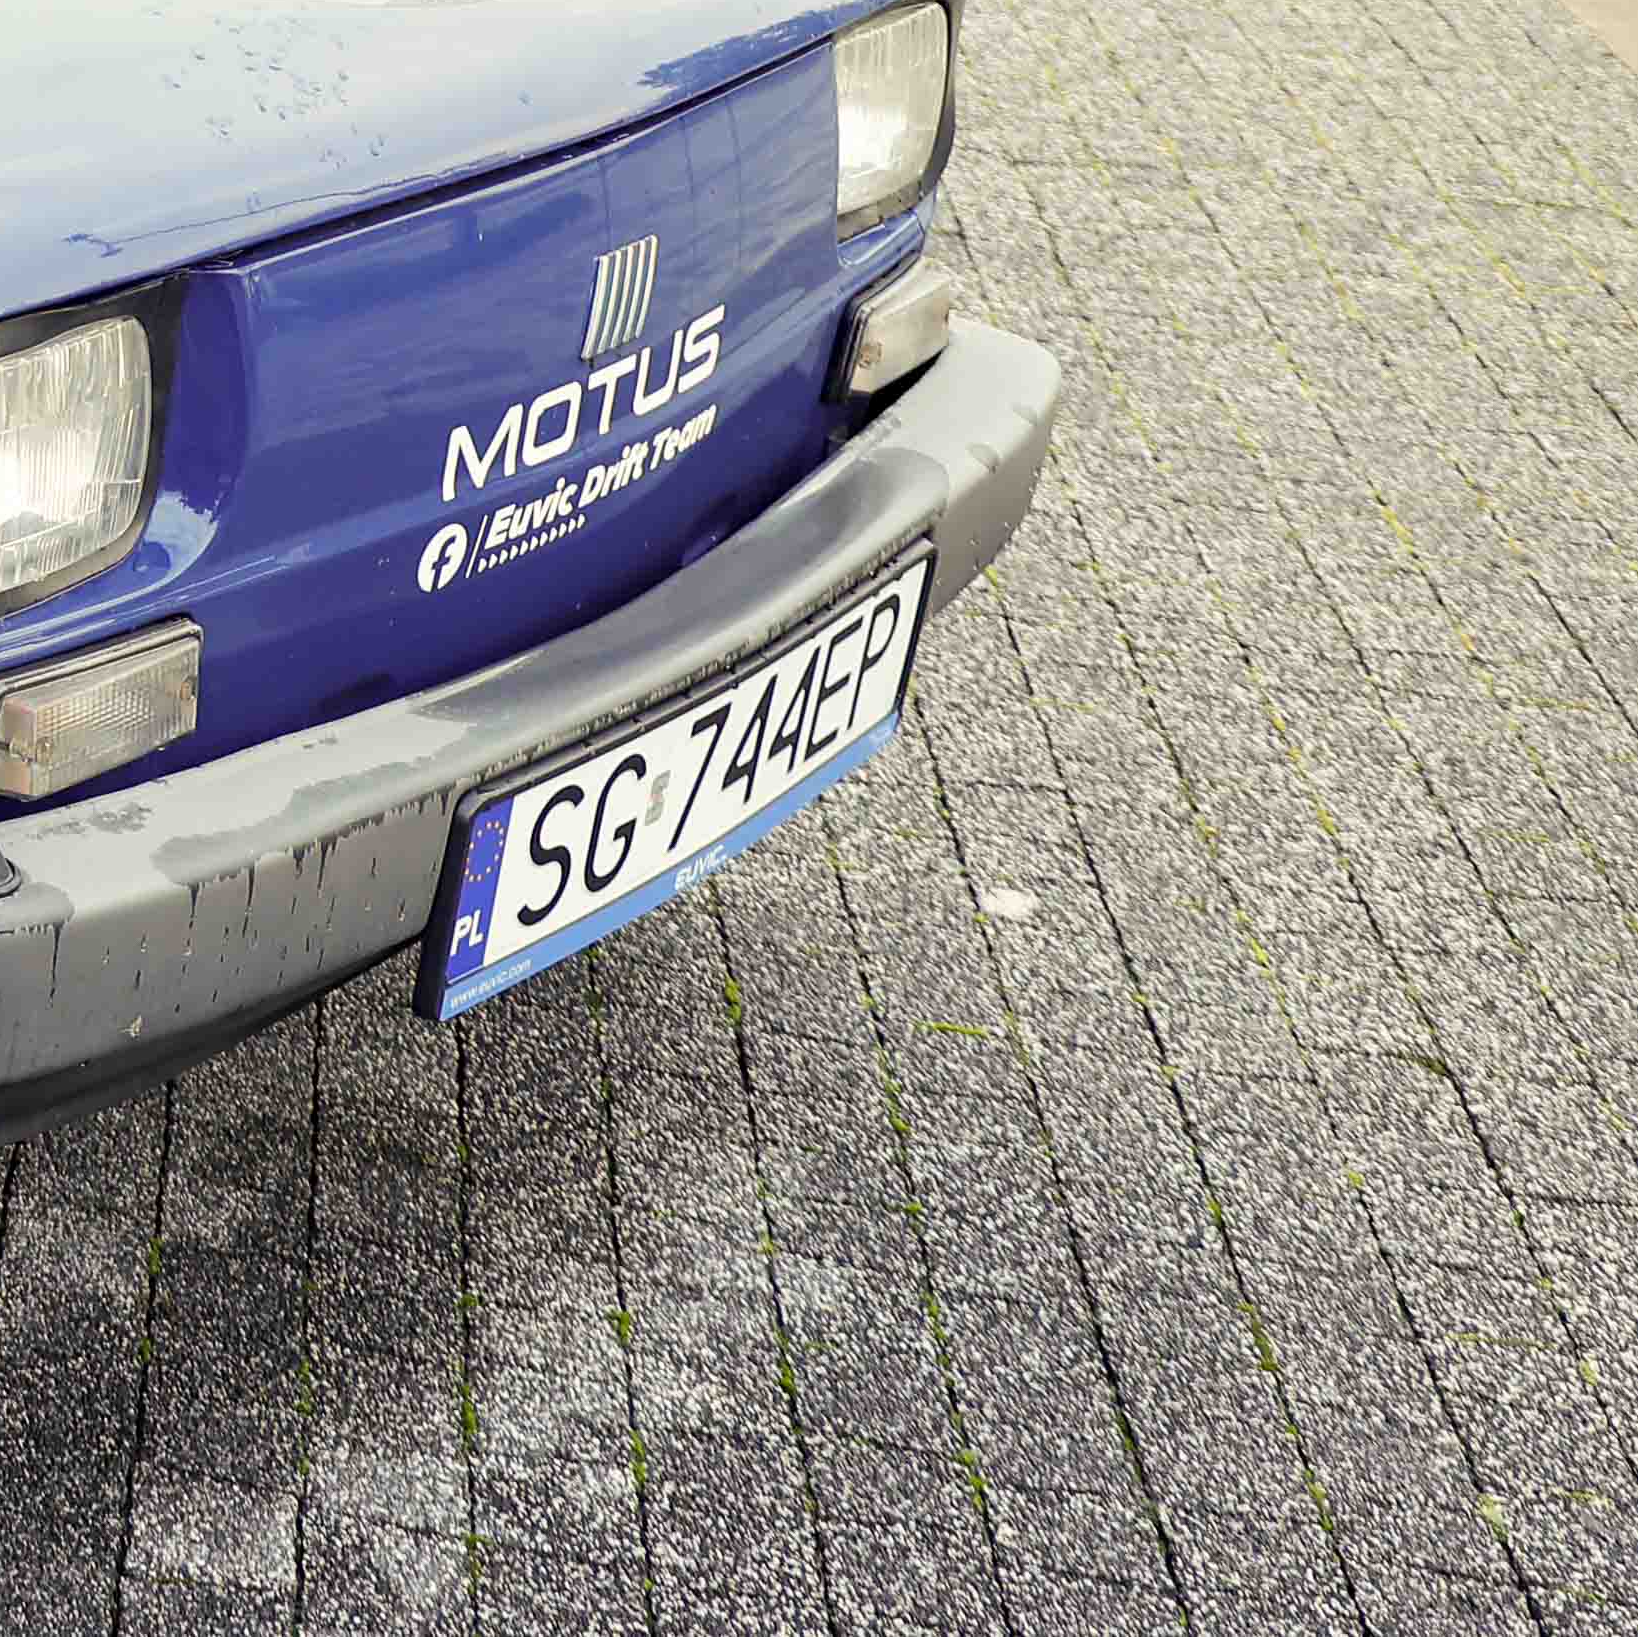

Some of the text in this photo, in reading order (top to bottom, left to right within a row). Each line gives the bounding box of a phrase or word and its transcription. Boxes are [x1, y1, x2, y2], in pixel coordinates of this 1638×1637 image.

[442, 305, 725, 502] MOTUS
[484, 404, 715, 550] Euvic Drift Team
[517, 593, 901, 928] SG 744EP
[448, 959, 533, 1010] www.euvic.com
[449, 913, 485, 957] PL
